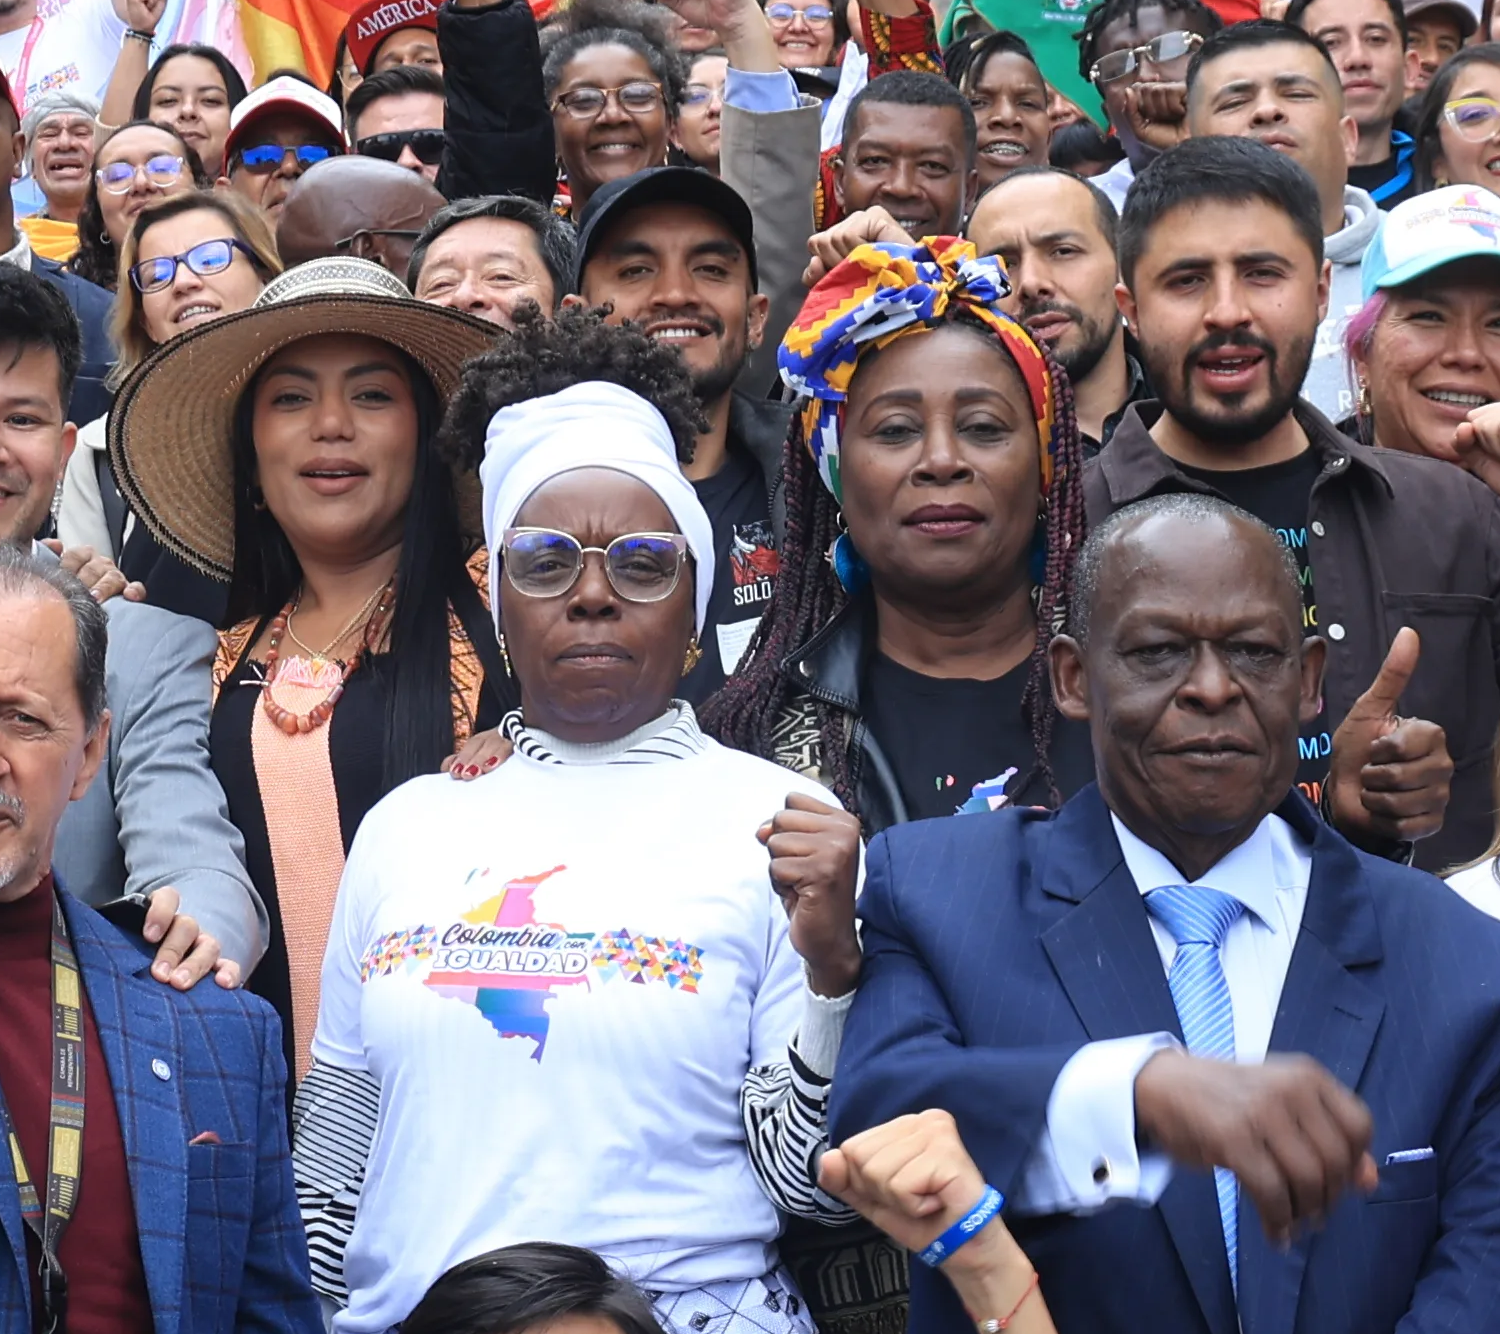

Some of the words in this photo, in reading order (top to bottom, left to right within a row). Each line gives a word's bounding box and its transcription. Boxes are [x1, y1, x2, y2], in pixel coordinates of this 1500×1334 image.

[441, 923, 559, 948] Colombia
[563, 940, 588, 950] con
[432, 949, 588, 975] IGUALDAD
